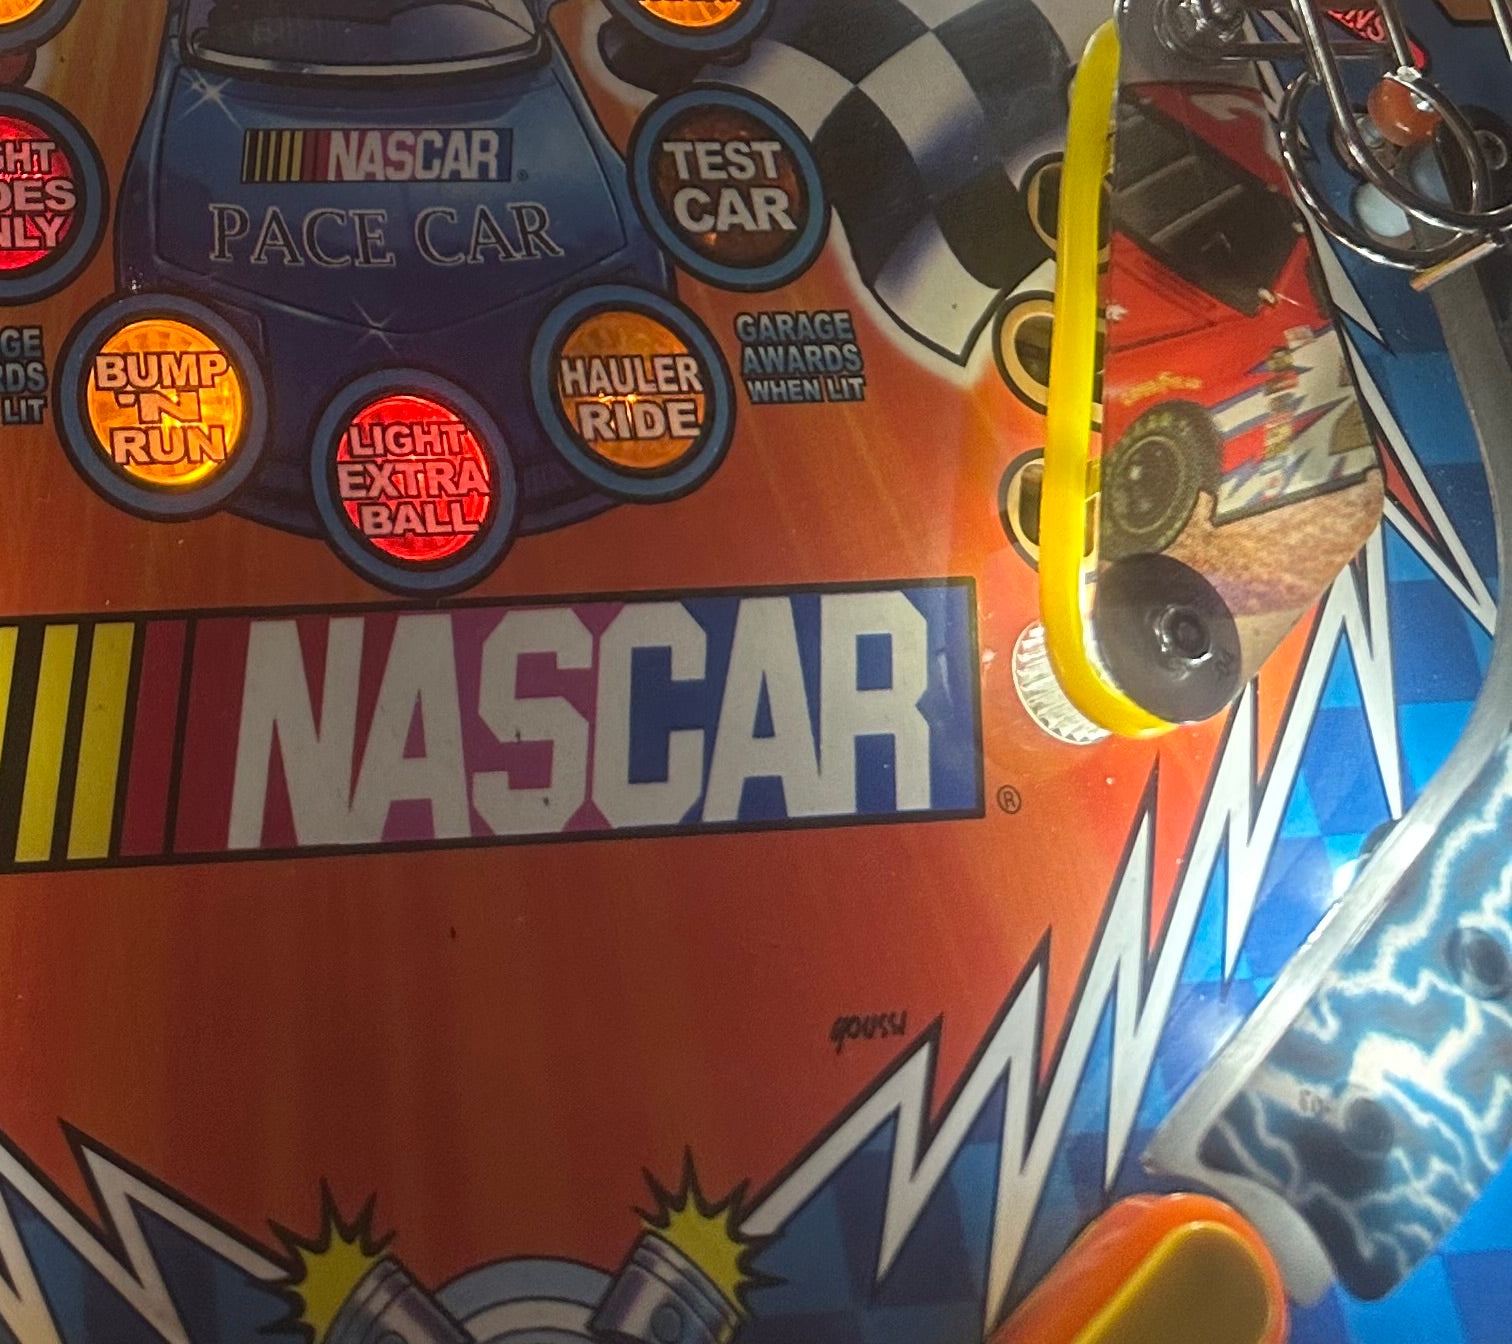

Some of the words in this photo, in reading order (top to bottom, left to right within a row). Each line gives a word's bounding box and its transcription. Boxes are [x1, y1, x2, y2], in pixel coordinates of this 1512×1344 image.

[326, 129, 501, 182] NASCAR
[662, 140, 781, 181] TEST
[671, 188, 797, 233] CAR
[209, 202, 395, 268] PACE
[415, 204, 565, 265] CAR
[735, 311, 853, 345] GARAGE
[95, 352, 228, 390] BUMP
[561, 355, 703, 398] HAULER
[740, 343, 863, 375] AWARDS
[117, 391, 202, 425] 'N
[746, 377, 824, 402] WHEN
[826, 375, 865, 402] LIT
[0, 397, 47, 425] LIT
[578, 402, 702, 442] RIDE
[112, 425, 226, 466] RUN
[348, 422, 468, 460] LIGHT
[336, 458, 489, 499] EXTRA
[361, 499, 480, 538] BALL
[228, 591, 934, 851] NASCAR
